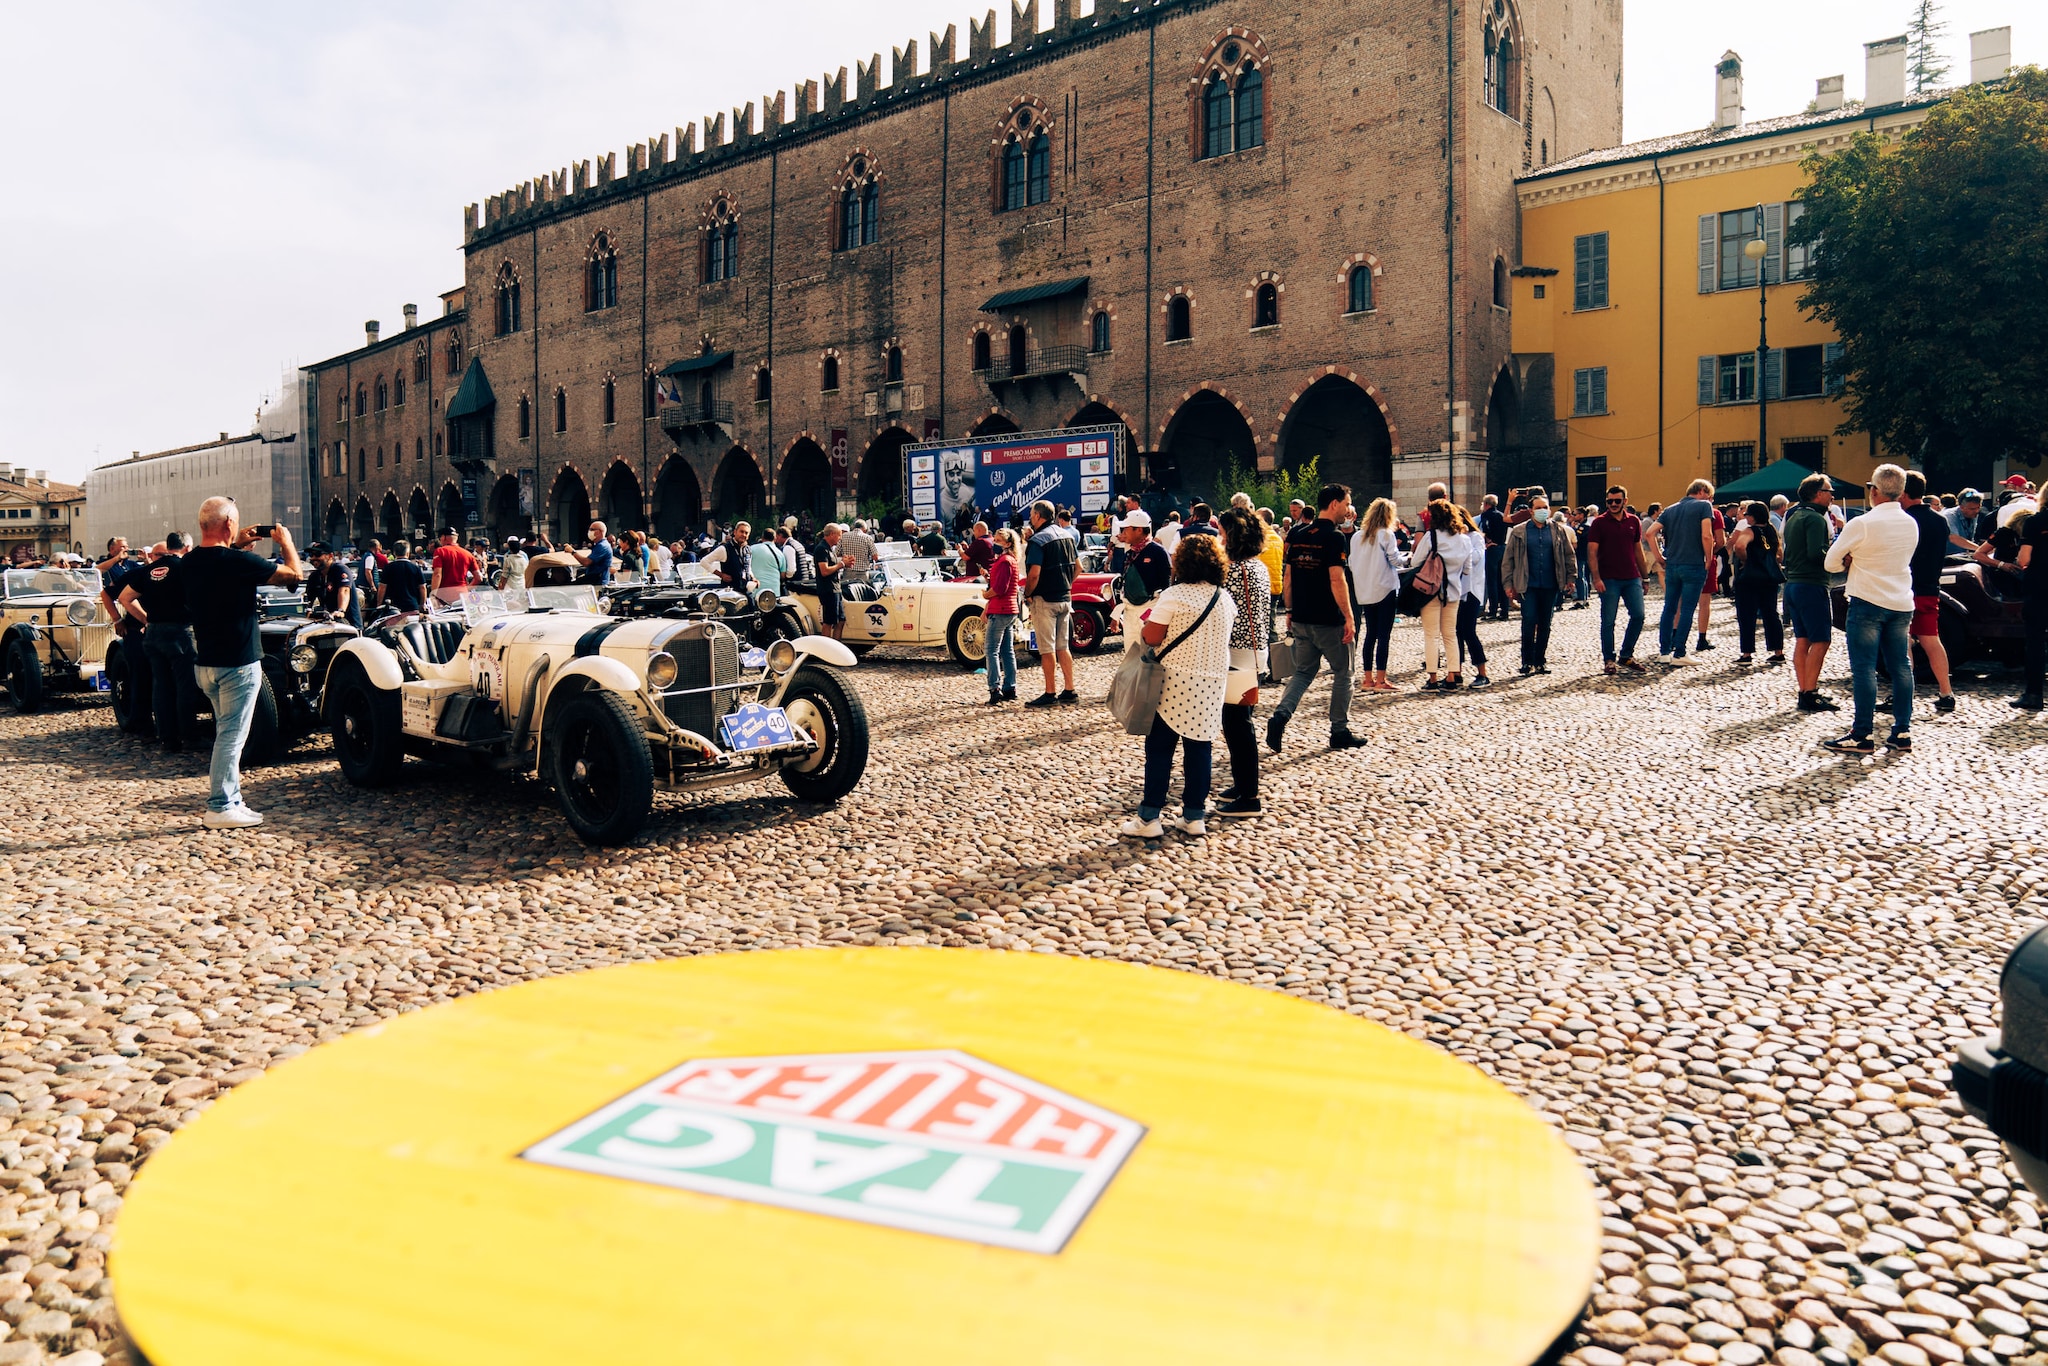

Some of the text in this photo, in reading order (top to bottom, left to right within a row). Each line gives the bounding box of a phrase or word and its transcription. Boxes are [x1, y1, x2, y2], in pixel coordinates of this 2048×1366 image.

[1003, 446, 1051, 457] PREMIO MANTOVA
[992, 464, 1044, 508] GRAN PREMIO
[993, 470, 1001, 479] 31
[1010, 467, 1063, 512] Nuvolari
[477, 672, 491, 698] 40
[769, 716, 785, 729] 40
[596, 1109, 1023, 1229] TAG
